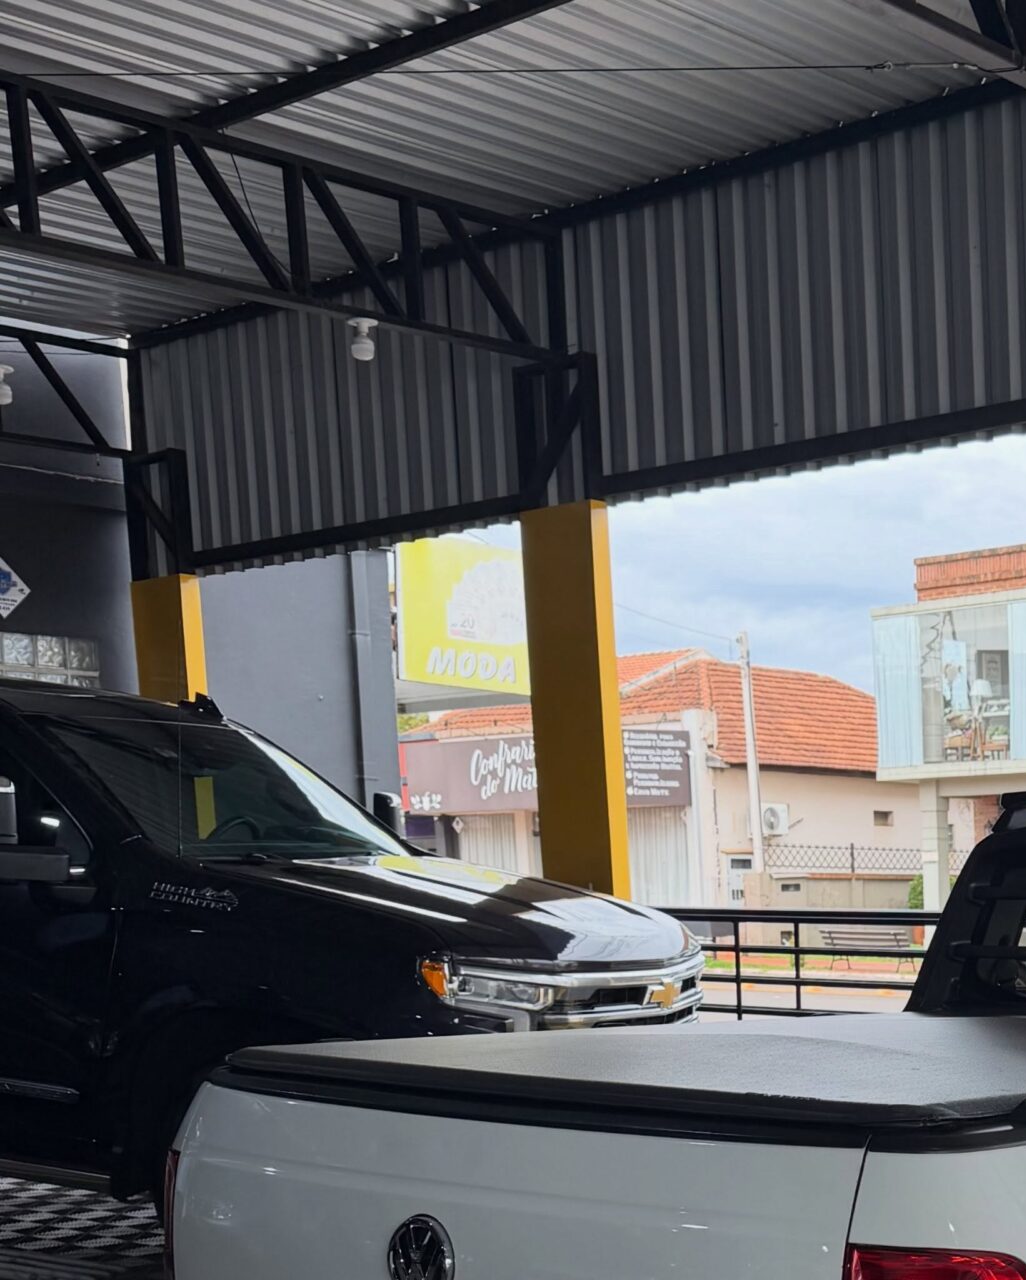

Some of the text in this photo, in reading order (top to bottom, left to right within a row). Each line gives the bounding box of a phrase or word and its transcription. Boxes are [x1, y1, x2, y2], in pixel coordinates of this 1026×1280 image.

[426, 647, 516, 683] MODA
[470, 740, 535, 785] Confrari
[481, 767, 538, 800] do Mat
